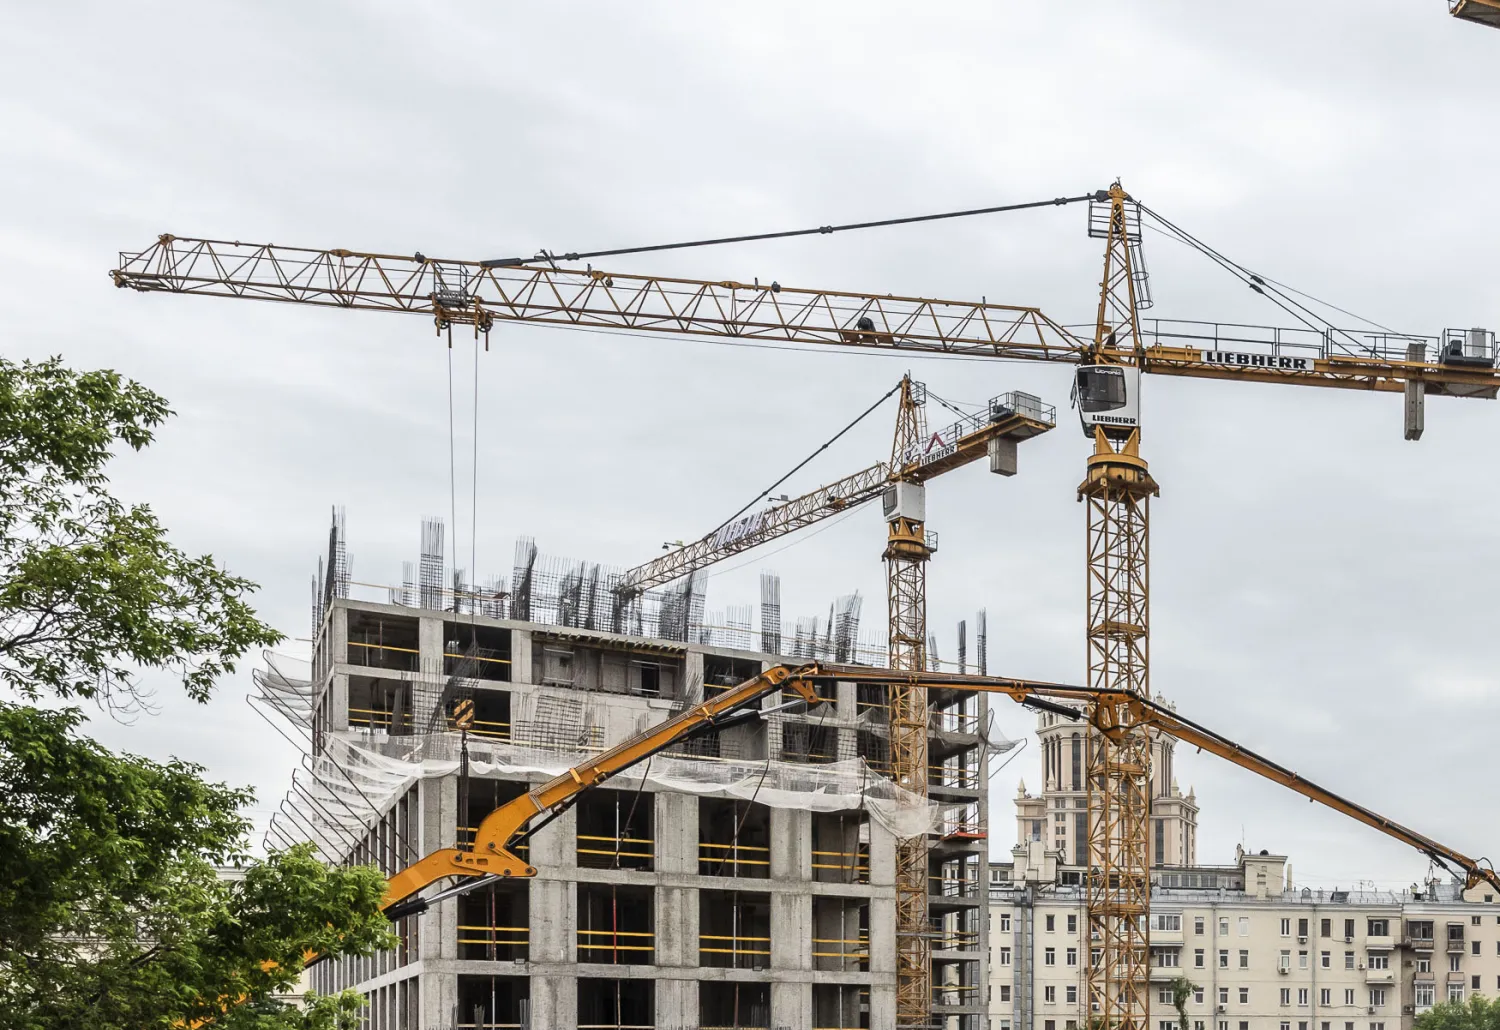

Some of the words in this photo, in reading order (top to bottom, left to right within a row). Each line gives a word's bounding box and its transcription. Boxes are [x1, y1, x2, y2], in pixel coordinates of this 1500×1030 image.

[1206, 351, 1307, 369] LIEBHERR
[1092, 414, 1137, 424] LIEBHERR
[921, 445, 955, 466] LIEBHERR
